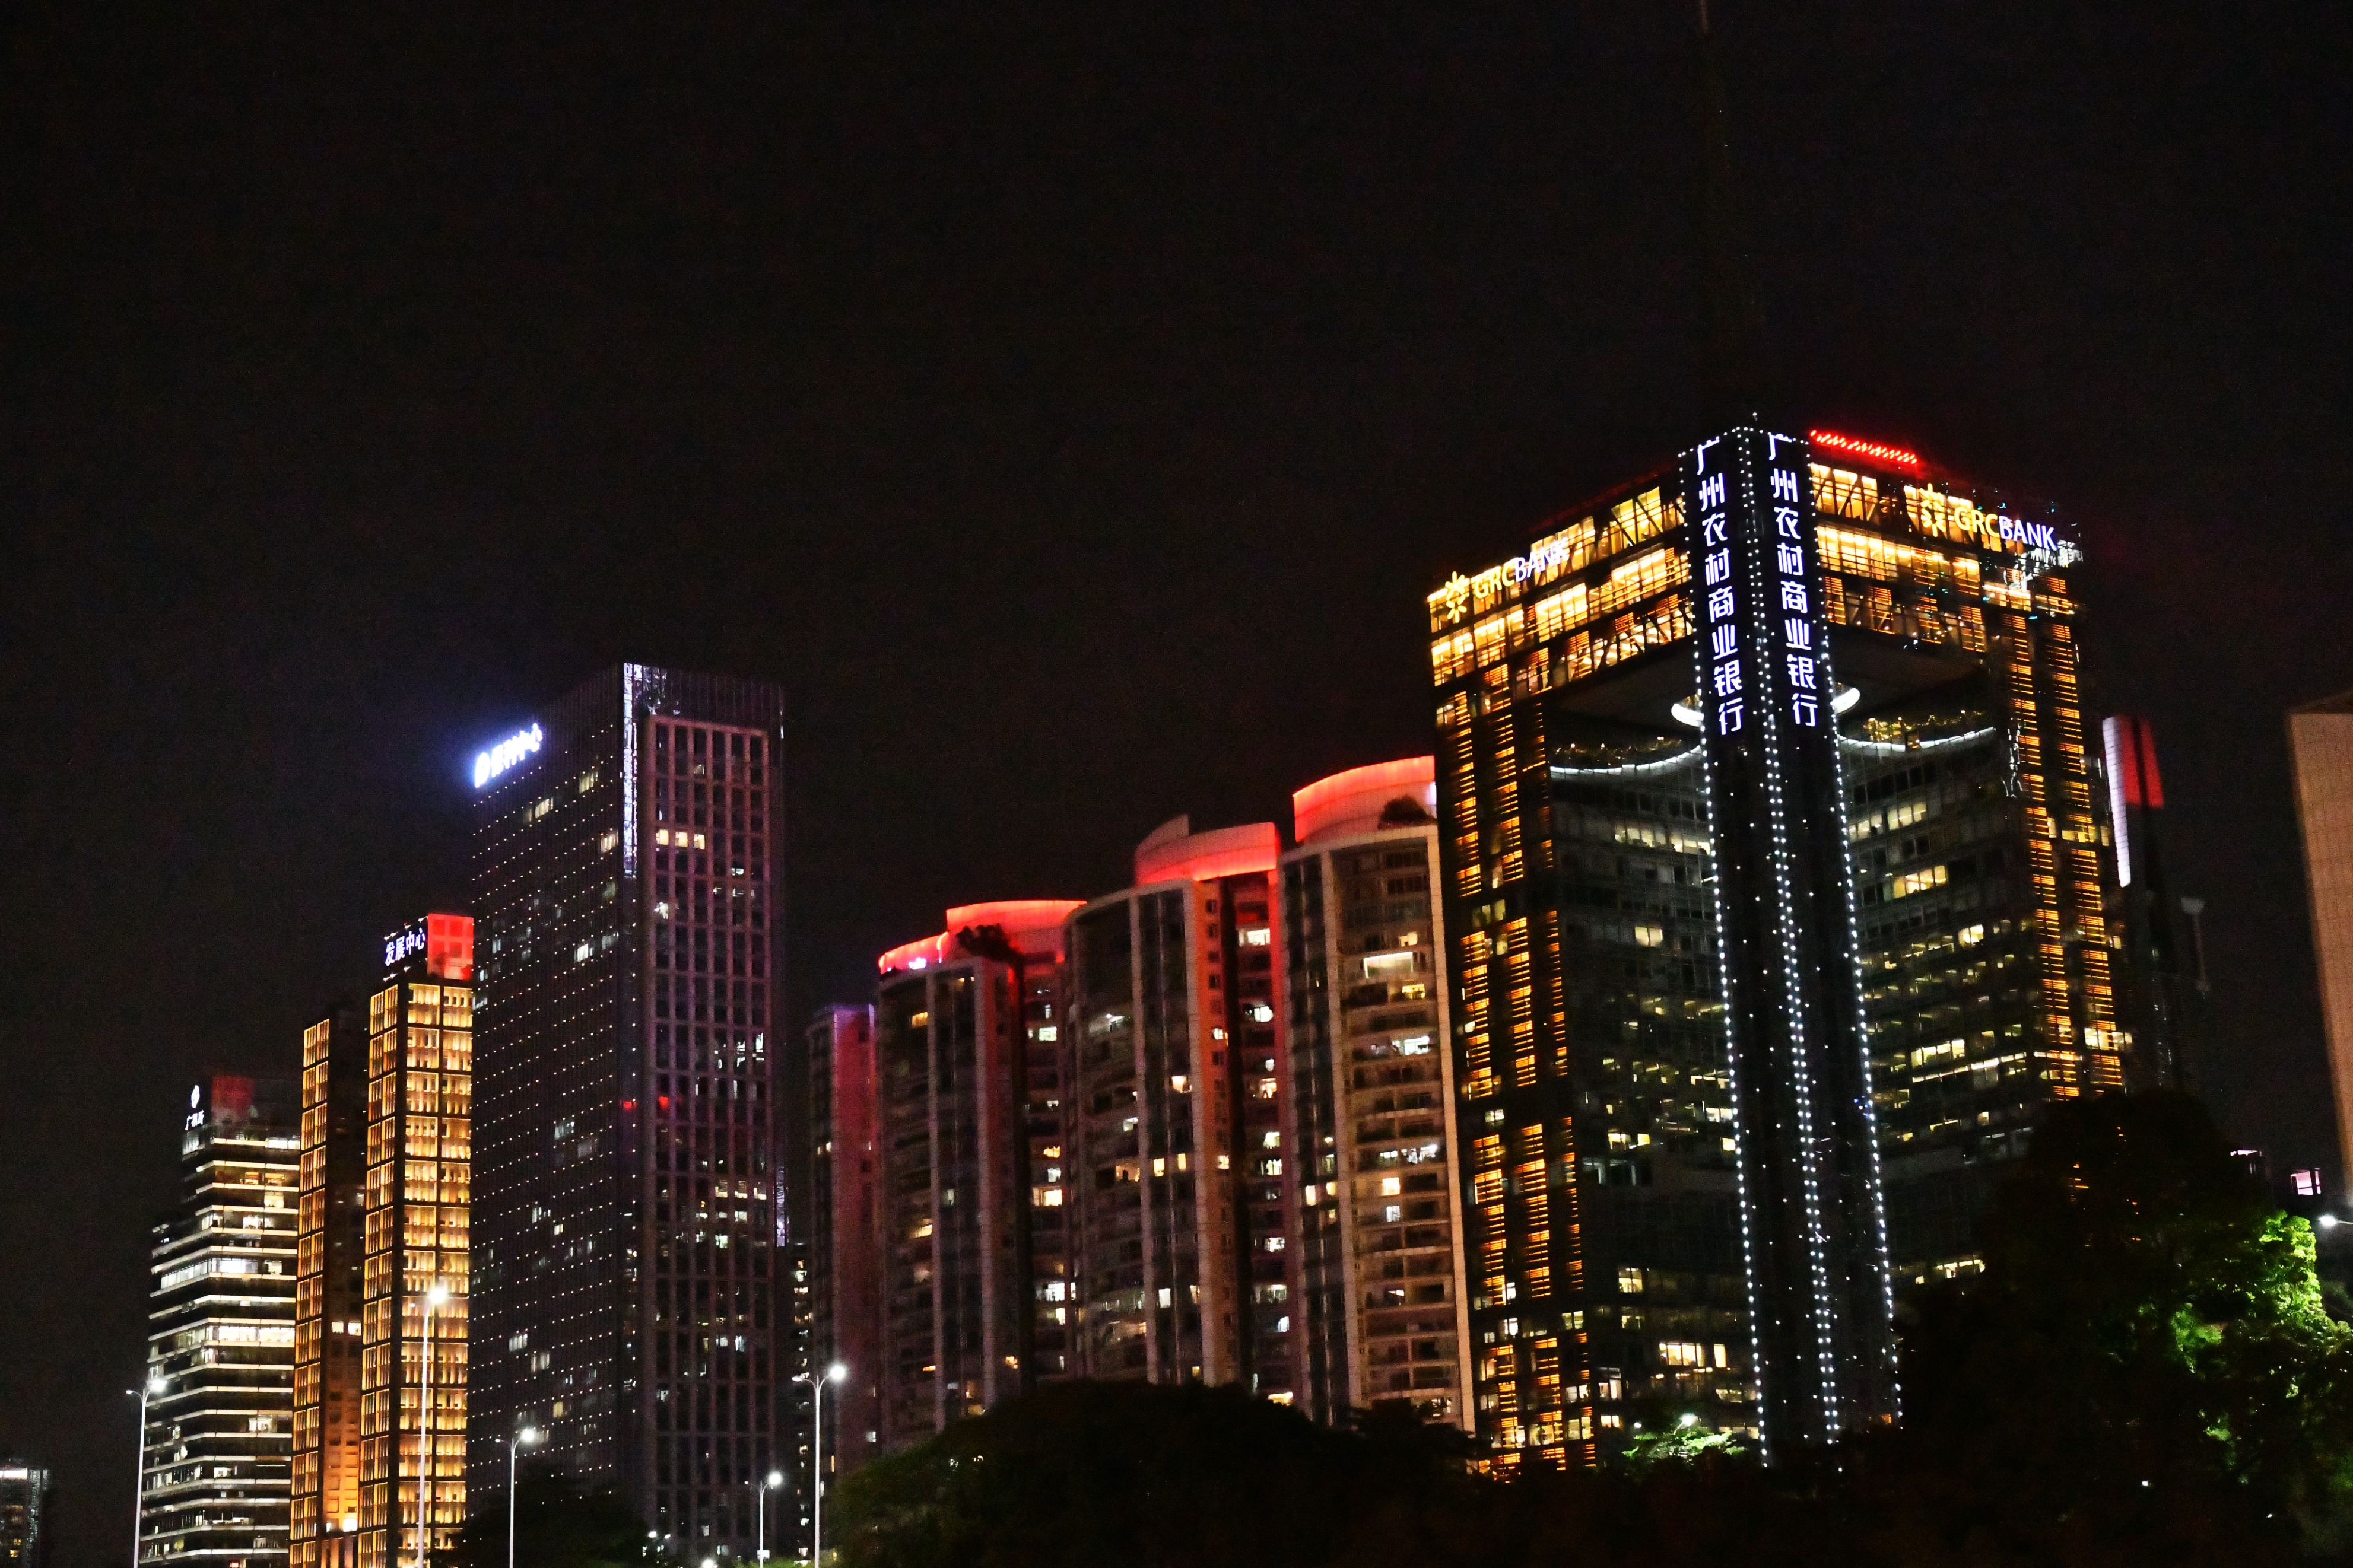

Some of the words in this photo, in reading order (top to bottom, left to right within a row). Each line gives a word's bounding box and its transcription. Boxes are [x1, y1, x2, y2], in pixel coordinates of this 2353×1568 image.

[1697, 437, 1744, 736] 广州农村商业银行
[1768, 434, 1818, 727] 广州农村商业银行
[1954, 507, 2057, 551] GRCBANK
[385, 927, 426, 966] 发展中心
